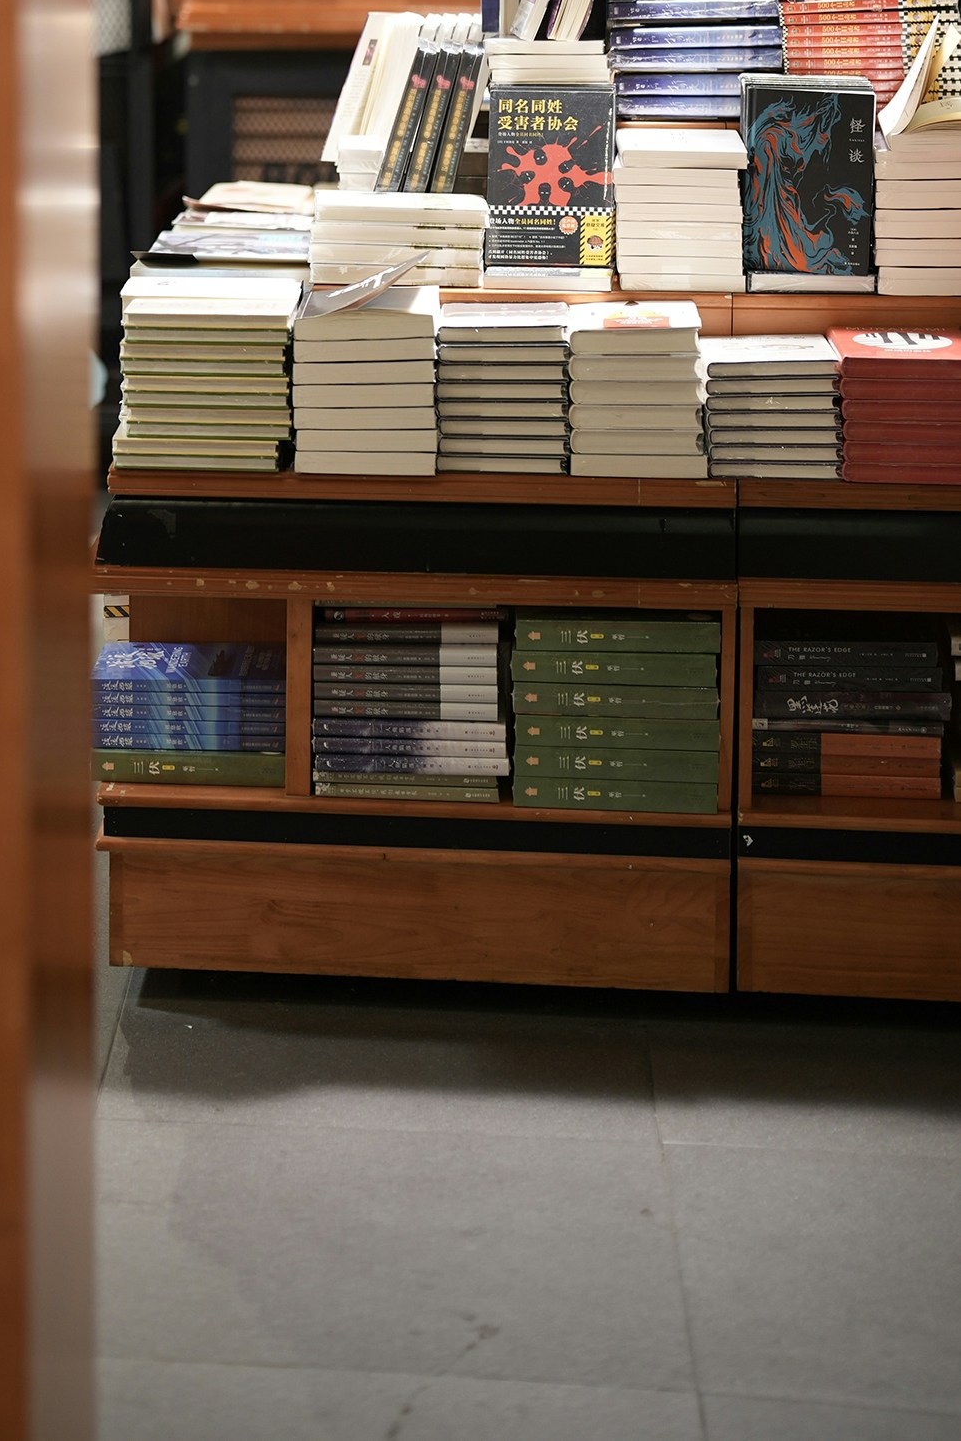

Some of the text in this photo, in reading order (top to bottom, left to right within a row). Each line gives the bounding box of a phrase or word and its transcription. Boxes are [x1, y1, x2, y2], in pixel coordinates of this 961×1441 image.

[498, 99, 563, 114] 同名同姓
[497, 115, 579, 131] 受害者协会
[848, 118, 866, 164] 怪谈
[560, 629, 589, 645] 三伏
[803, 646, 831, 654] RAZOR'S
[165, 646, 184, 674] WANDERING
[556, 659, 584, 675] 三伏
[557, 691, 586, 707] 三伏
[559, 725, 587, 741] 三伏
[133, 760, 160, 775] 三伏
[558, 755, 587, 770] 三伏
[557, 786, 585, 802] 三伏
